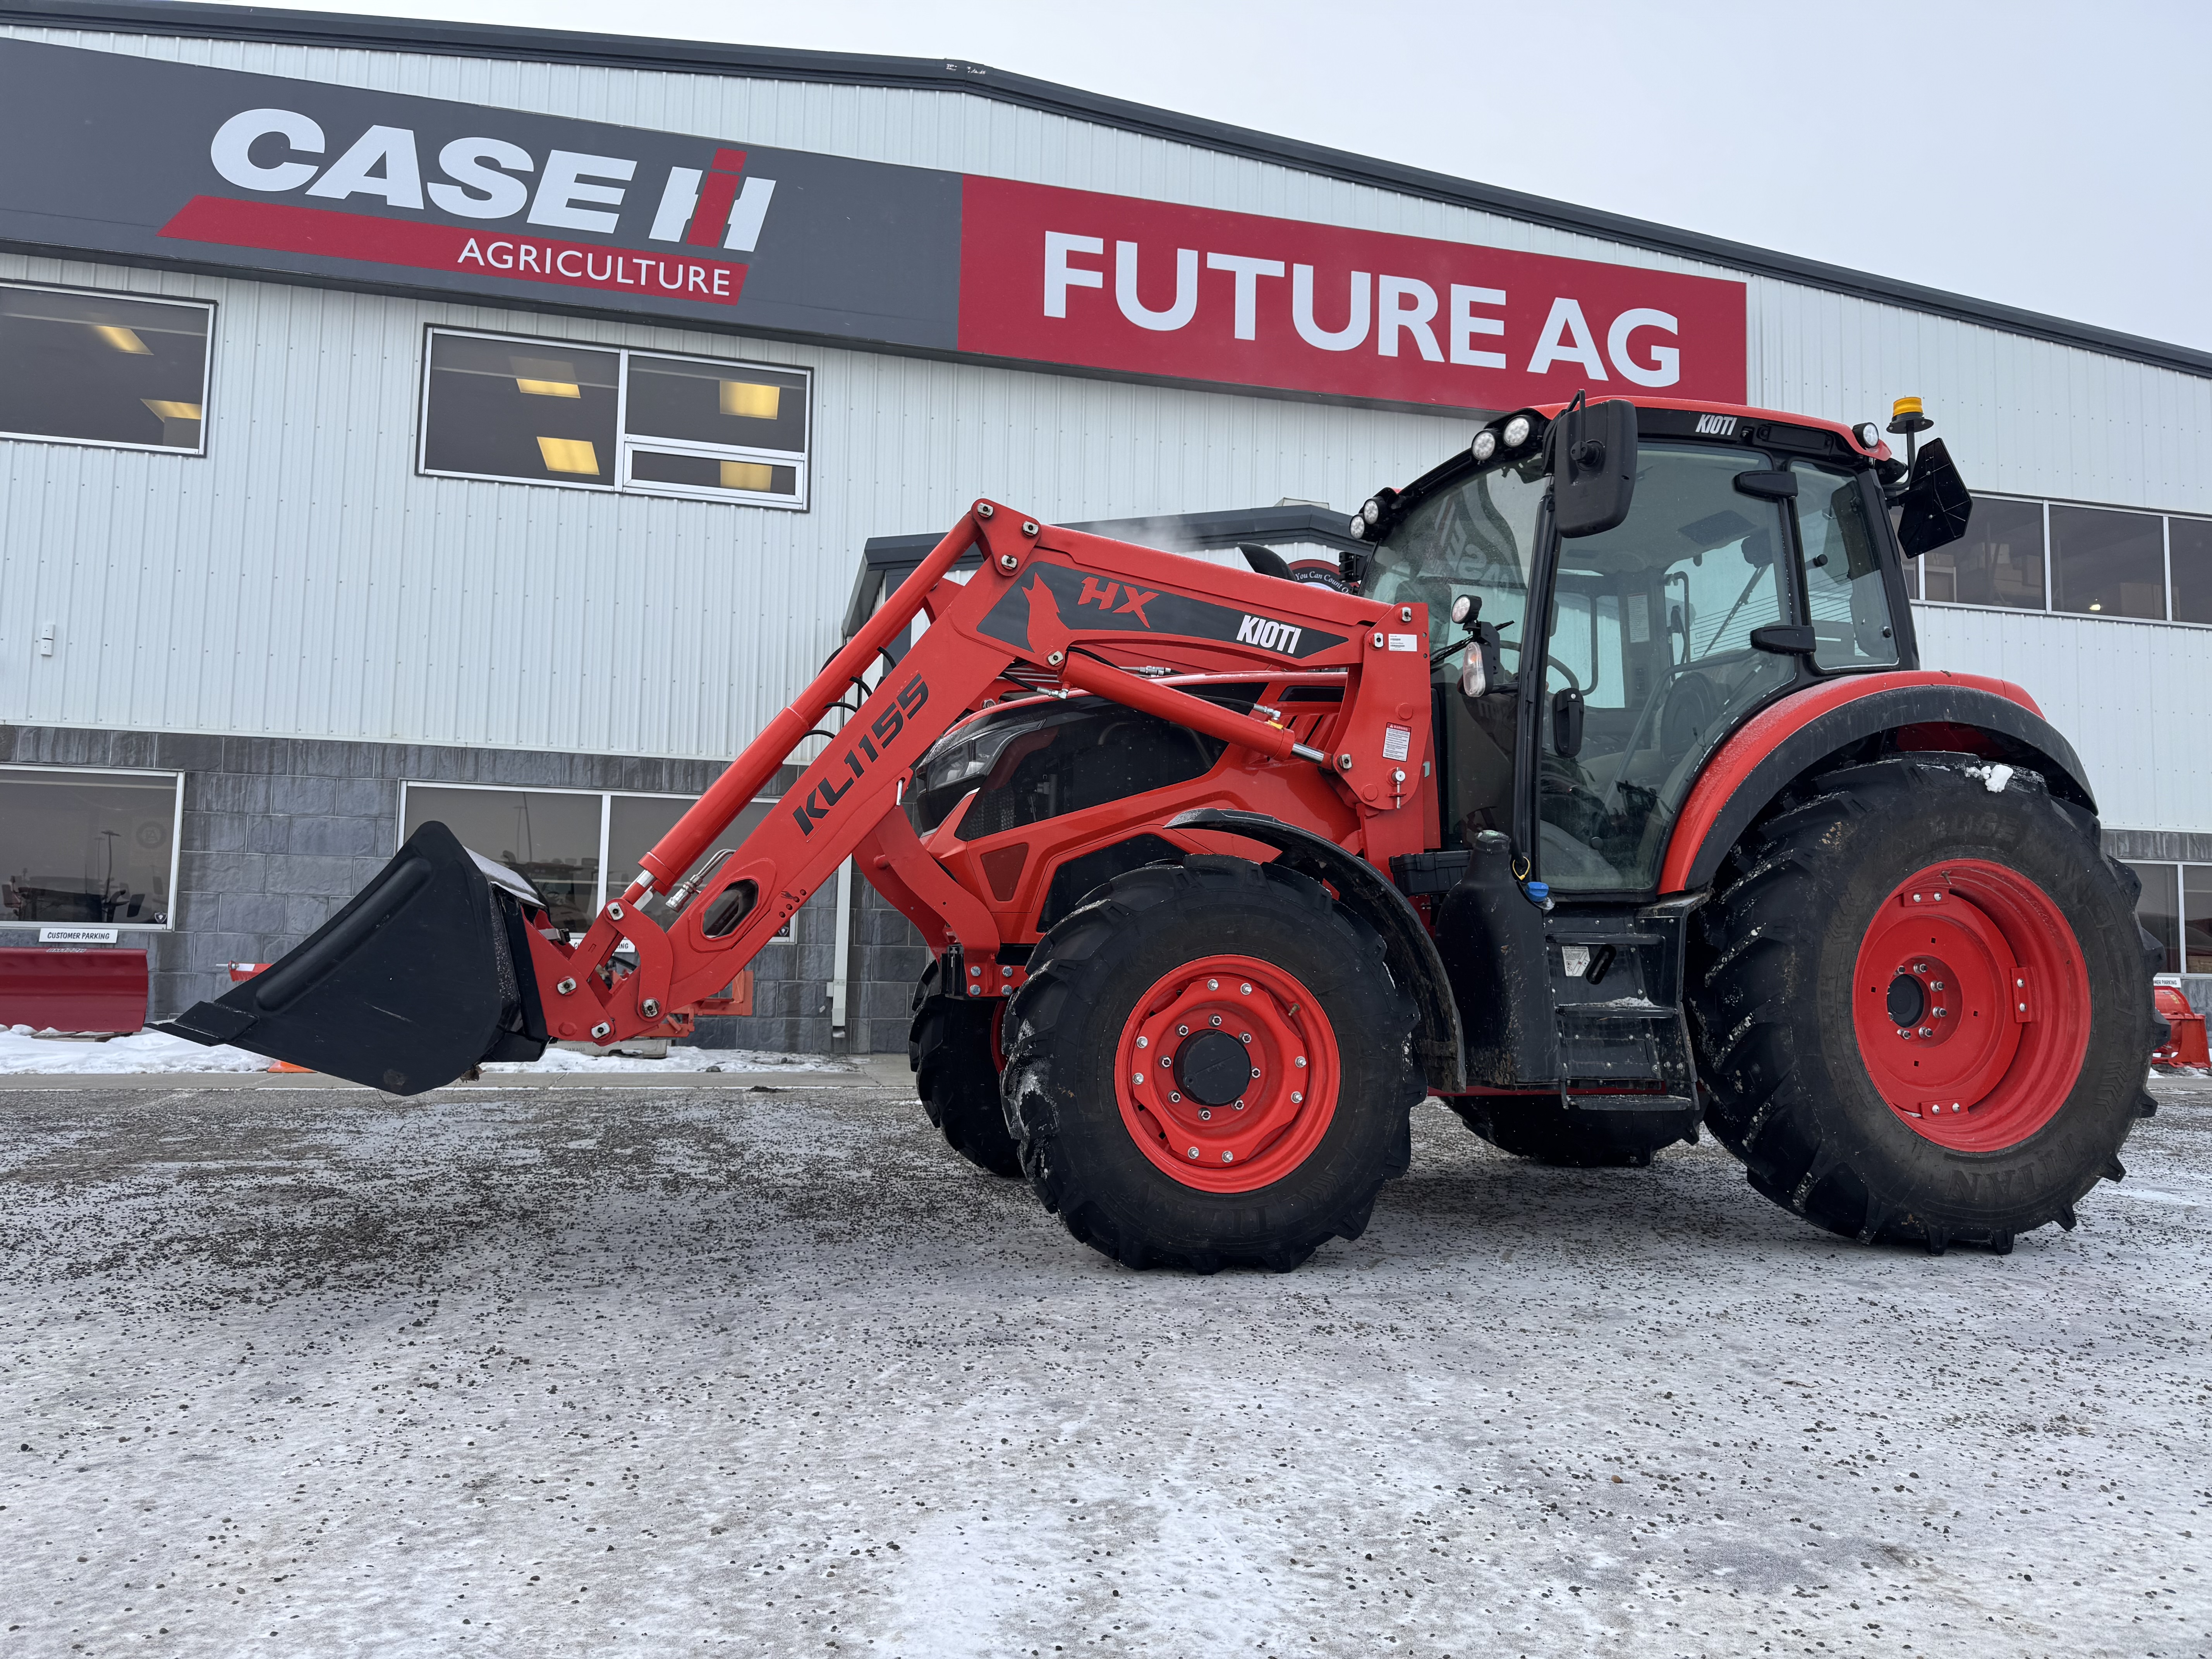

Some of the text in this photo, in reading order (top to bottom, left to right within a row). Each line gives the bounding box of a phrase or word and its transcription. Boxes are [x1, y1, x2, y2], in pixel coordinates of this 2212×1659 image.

[211, 109, 637, 233] CASE
[458, 238, 730, 296] AGRICULTURE
[1044, 231, 1679, 387] FUTURE AG
[1695, 414, 1738, 435] KIOTI
[1078, 577, 1159, 628] HX
[1324, 574, 1342, 589] Count
[1237, 615, 1302, 654] KIOTI
[793, 673, 929, 836] KL1155
